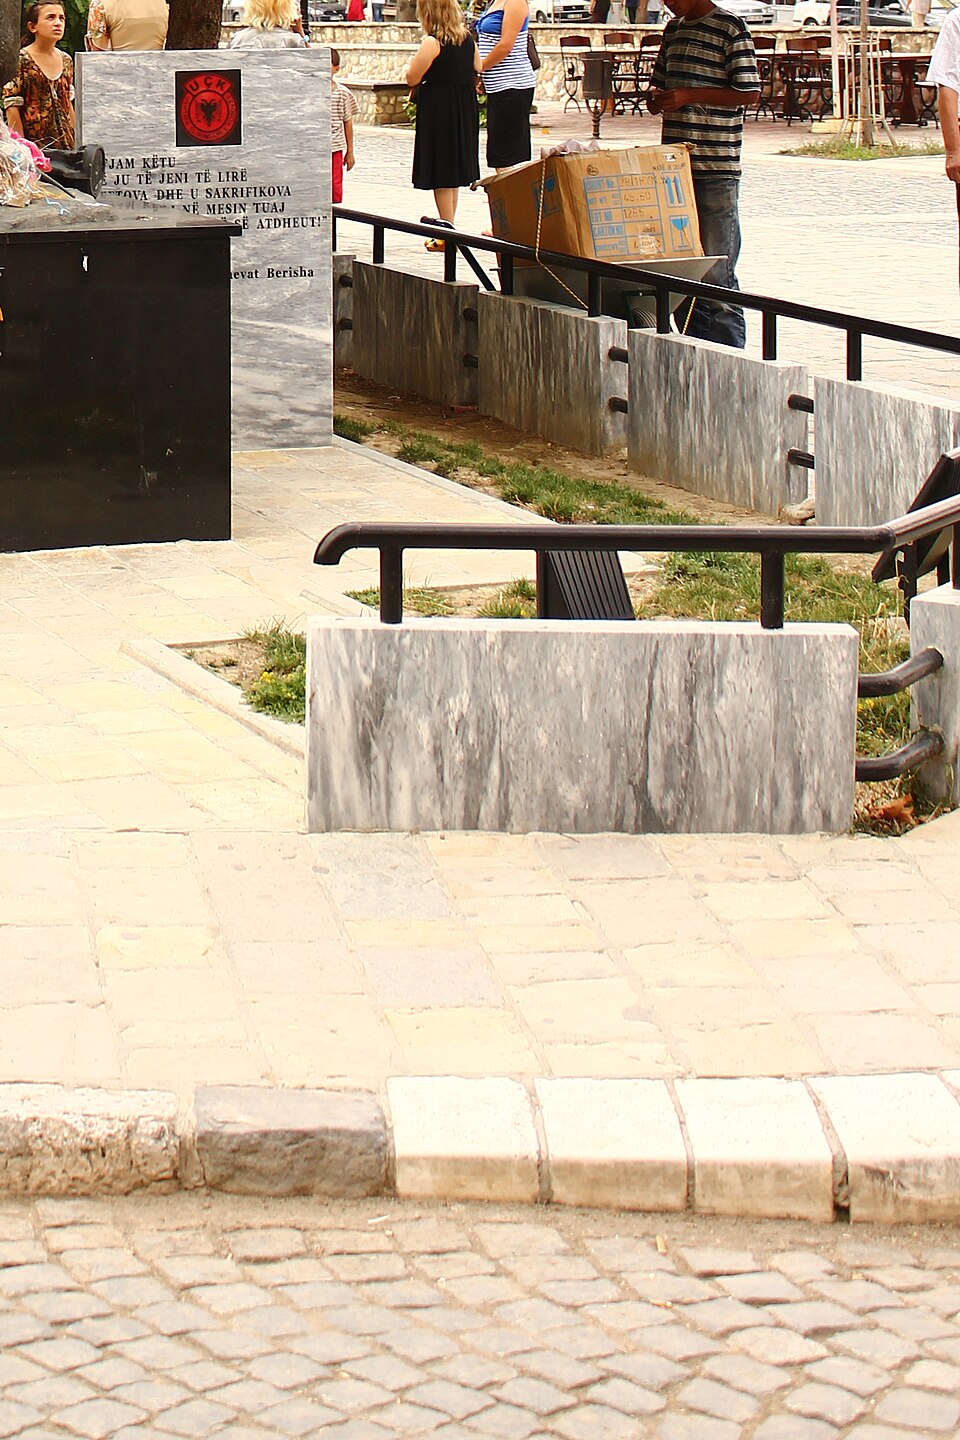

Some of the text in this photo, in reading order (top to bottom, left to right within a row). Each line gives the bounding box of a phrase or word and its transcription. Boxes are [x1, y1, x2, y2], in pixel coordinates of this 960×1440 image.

[189, 76, 227, 91] UÇK
[142, 155, 176, 169] KËTU
[114, 174, 130, 186] JU
[137, 171, 152, 185] TË
[159, 172, 188, 184] JENI
[195, 169, 211, 183] TË
[218, 168, 248, 182] LIRË
[157, 189, 183, 200] DHE
[191, 188, 199, 199] U
[205, 186, 291, 199] SAKRIFIKOVA
[206, 203, 247, 215] MESIN
[253, 202, 285, 213] TUAJ
[267, 266, 315, 279] Berisha
